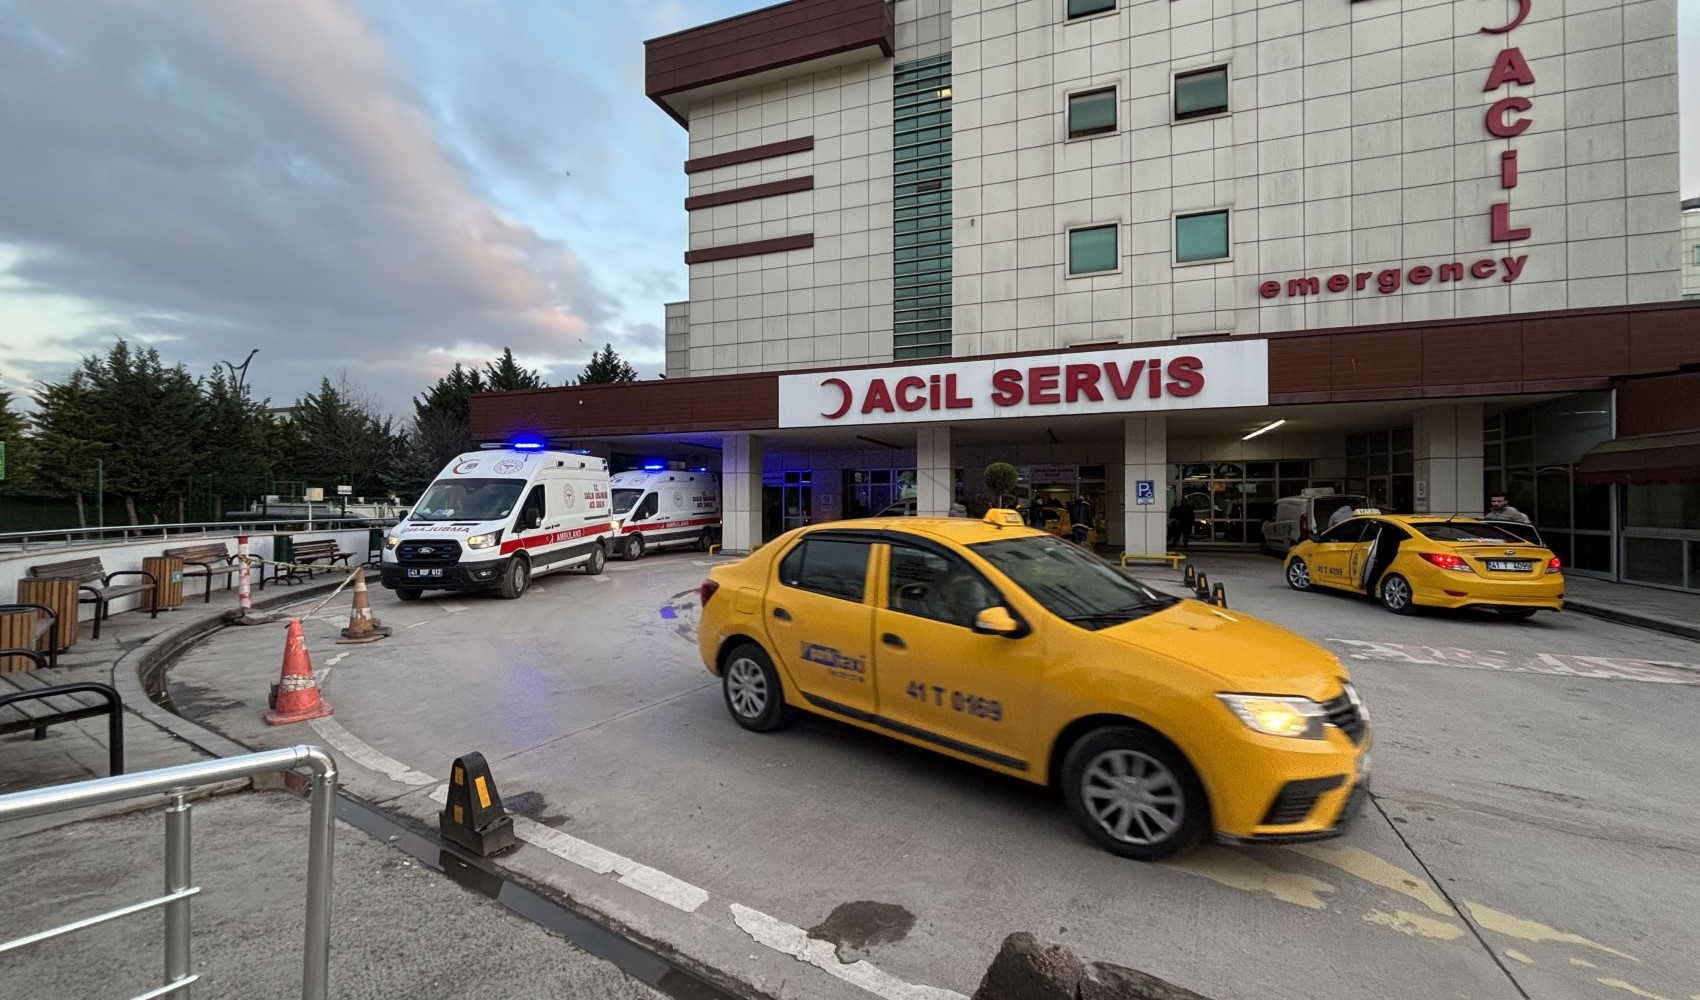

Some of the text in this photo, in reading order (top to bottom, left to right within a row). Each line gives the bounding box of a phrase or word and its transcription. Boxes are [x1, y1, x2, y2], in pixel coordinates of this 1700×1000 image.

[1260, 254, 1529, 299] emergency
[556, 529, 582, 542] AMBULANS
[906, 680, 927, 702] 41
[931, 686, 946, 706] T
